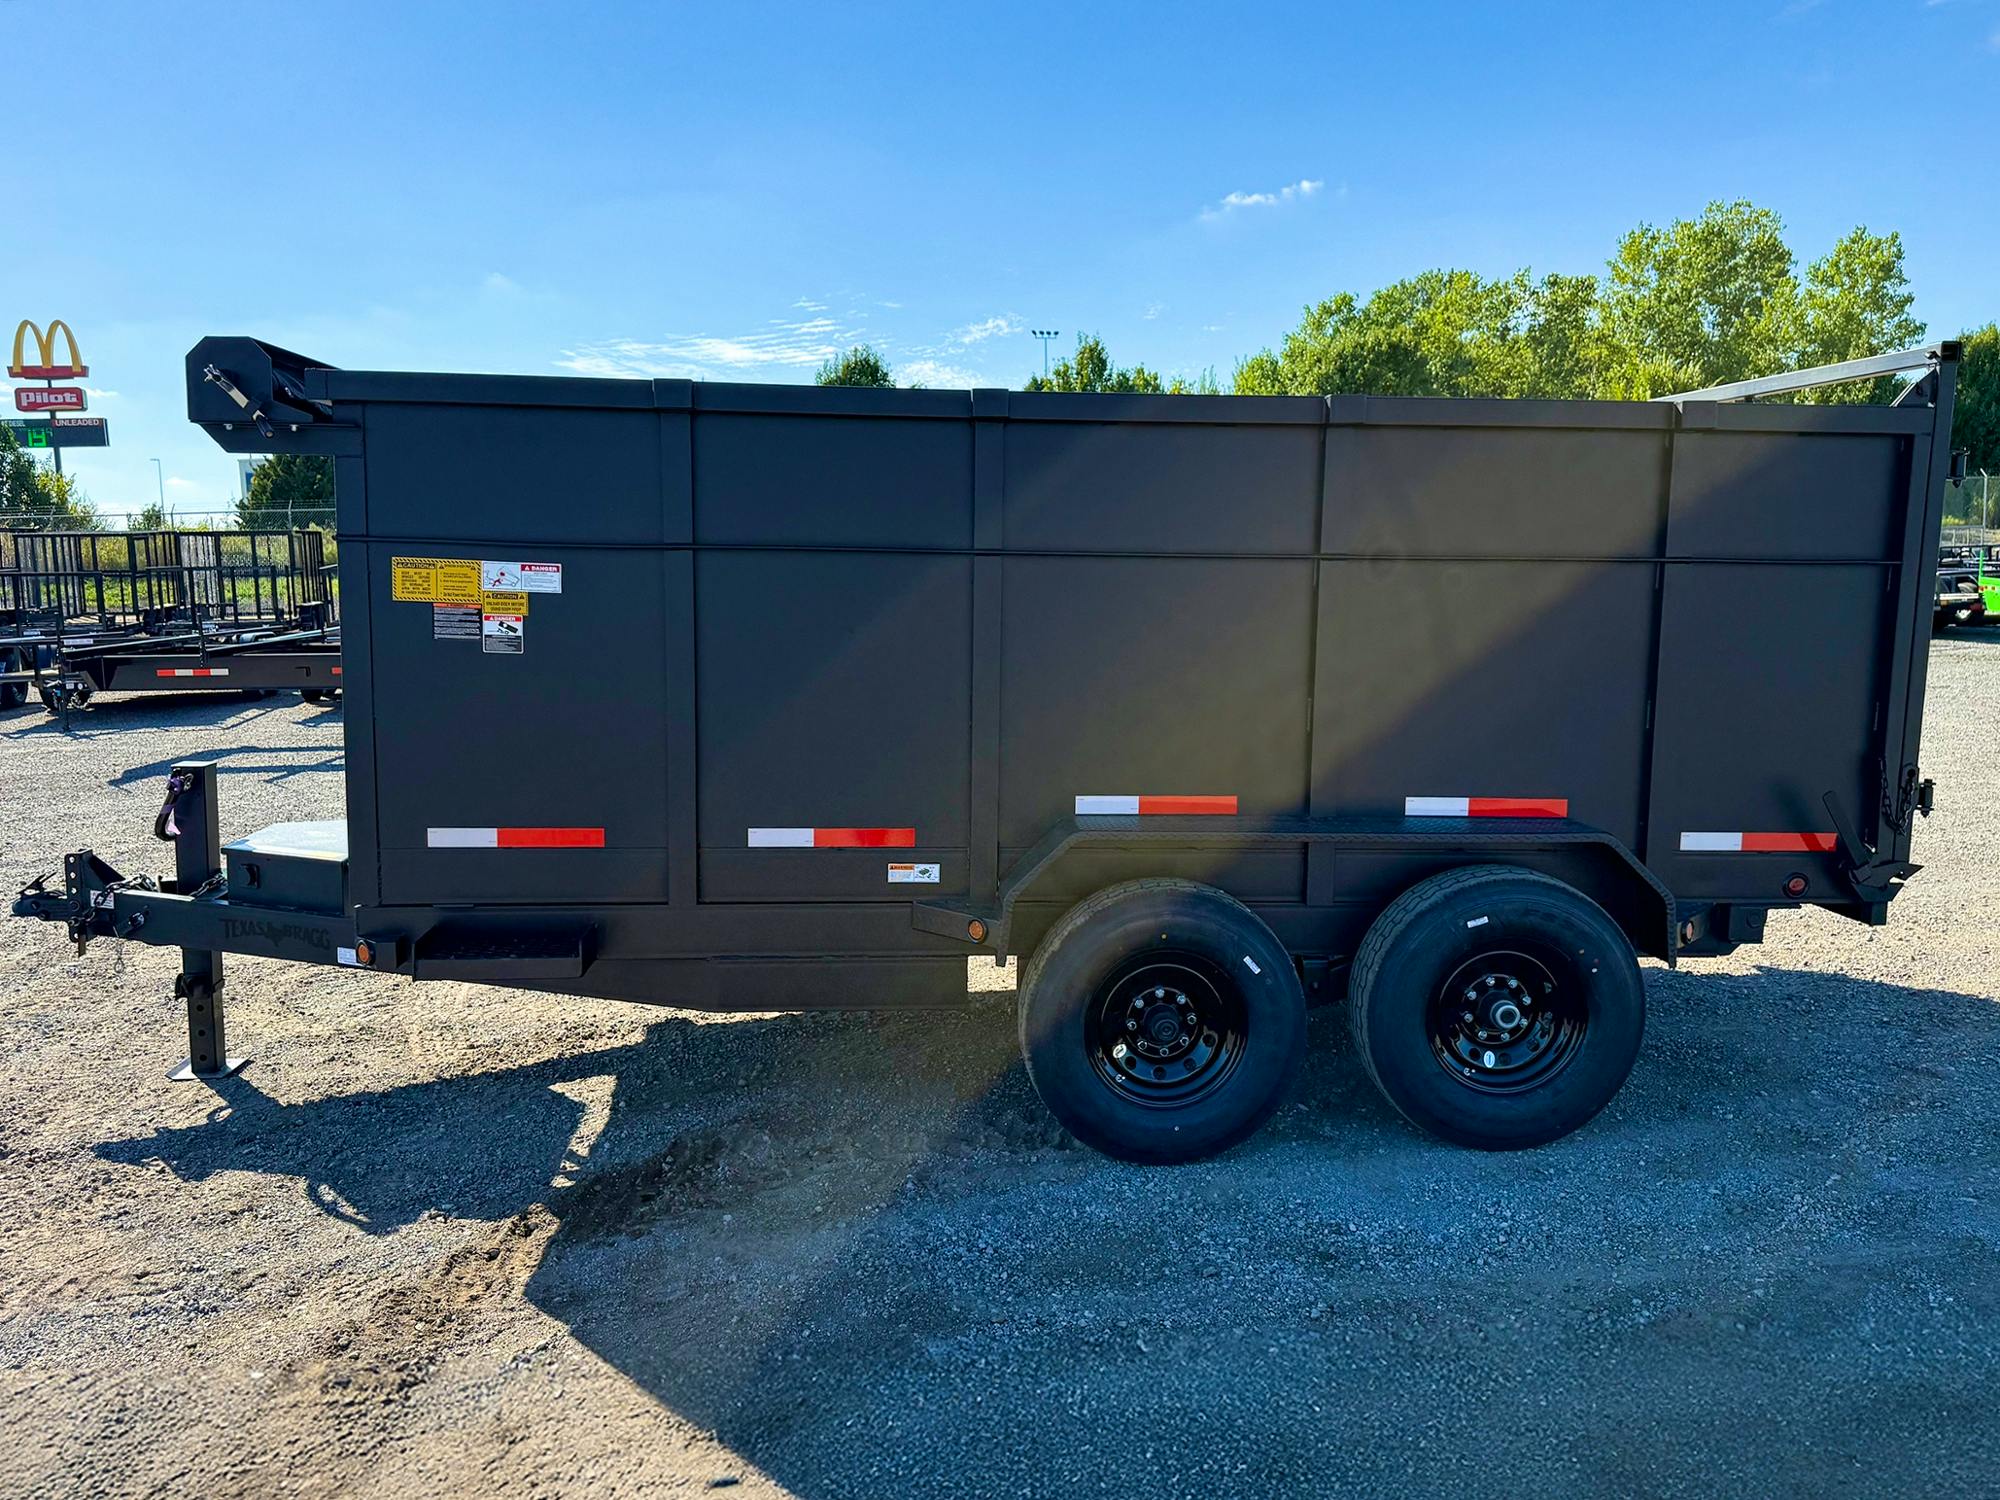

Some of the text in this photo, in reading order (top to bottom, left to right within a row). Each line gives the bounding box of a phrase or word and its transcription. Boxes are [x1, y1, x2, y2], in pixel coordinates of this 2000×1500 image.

[20, 392, 78, 407] Pilot
[55, 419, 100, 427] UNLEADED
[219, 918, 264, 938] TEXAS
